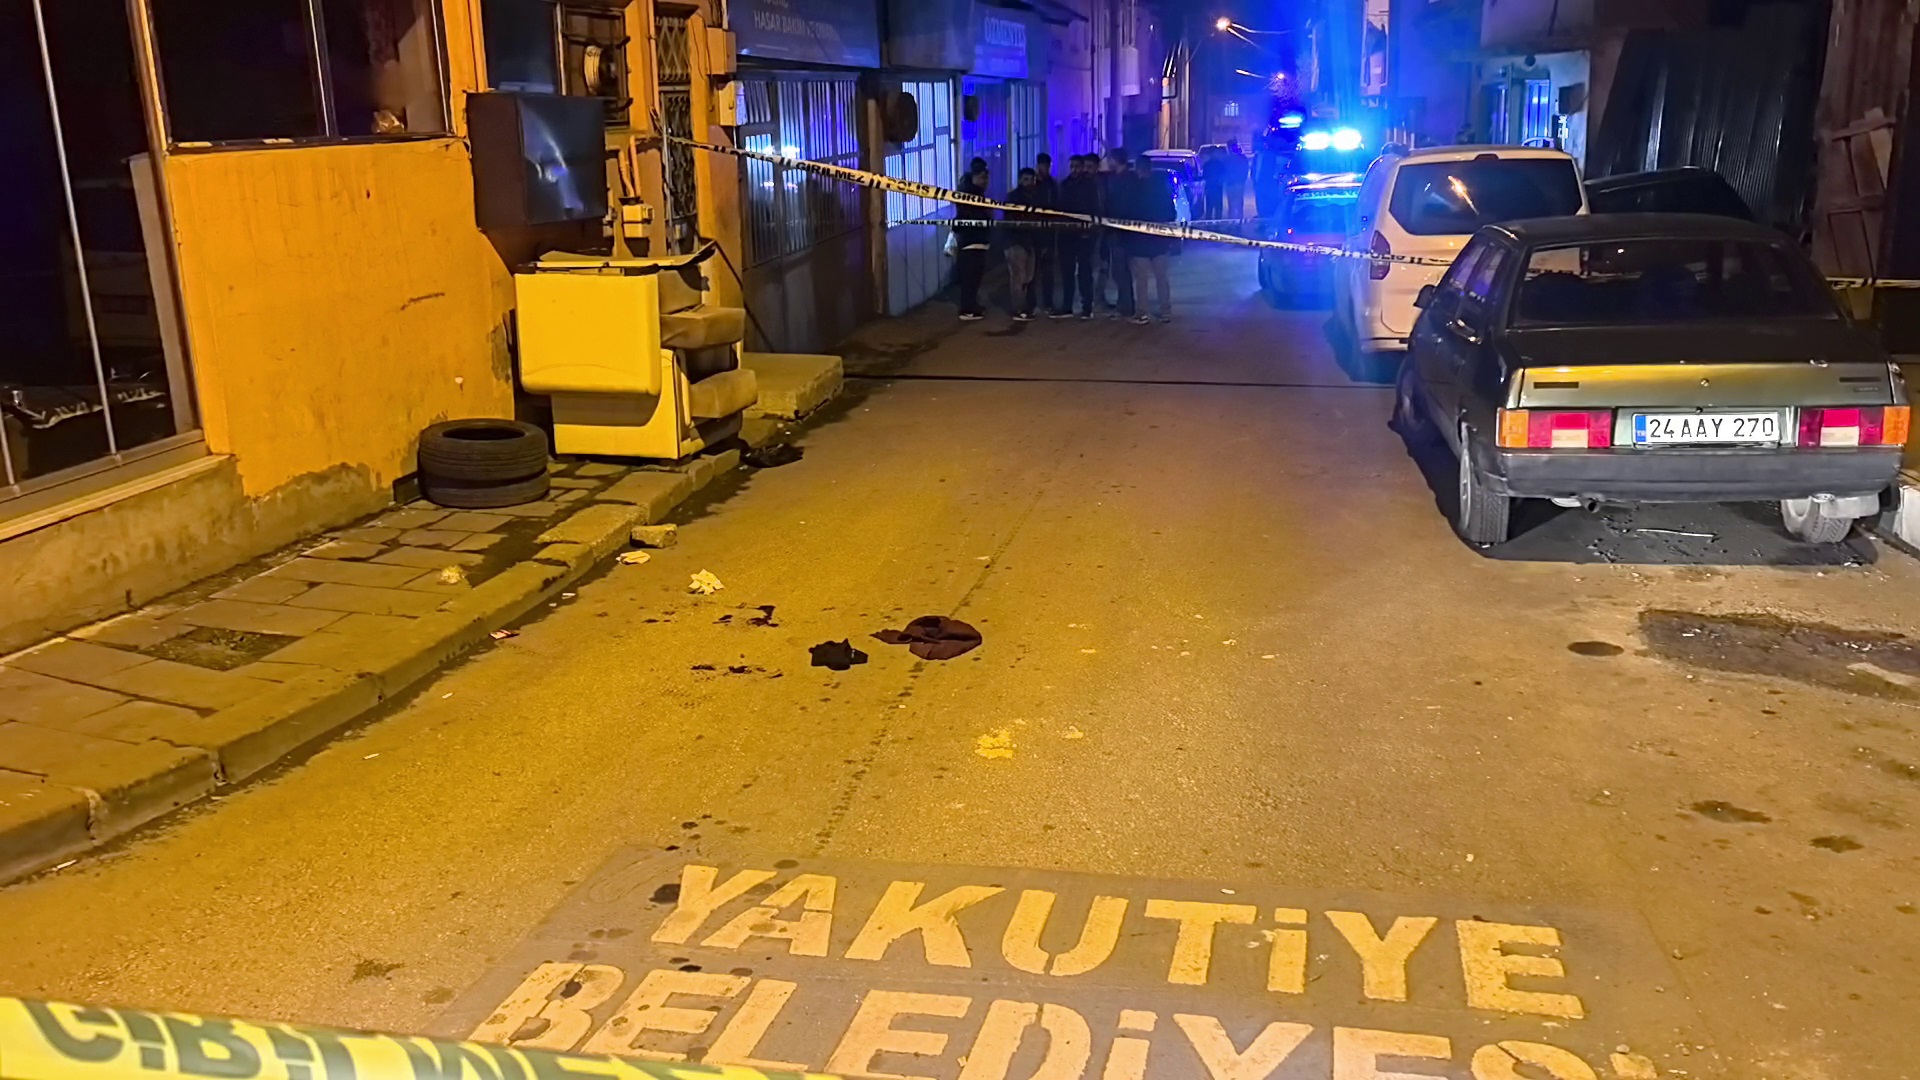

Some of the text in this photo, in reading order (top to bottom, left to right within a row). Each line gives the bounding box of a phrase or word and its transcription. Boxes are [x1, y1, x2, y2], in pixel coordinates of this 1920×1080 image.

[753, 9, 780, 32] HASAR
[1649, 417, 1774, 438] 24 AAY 270
